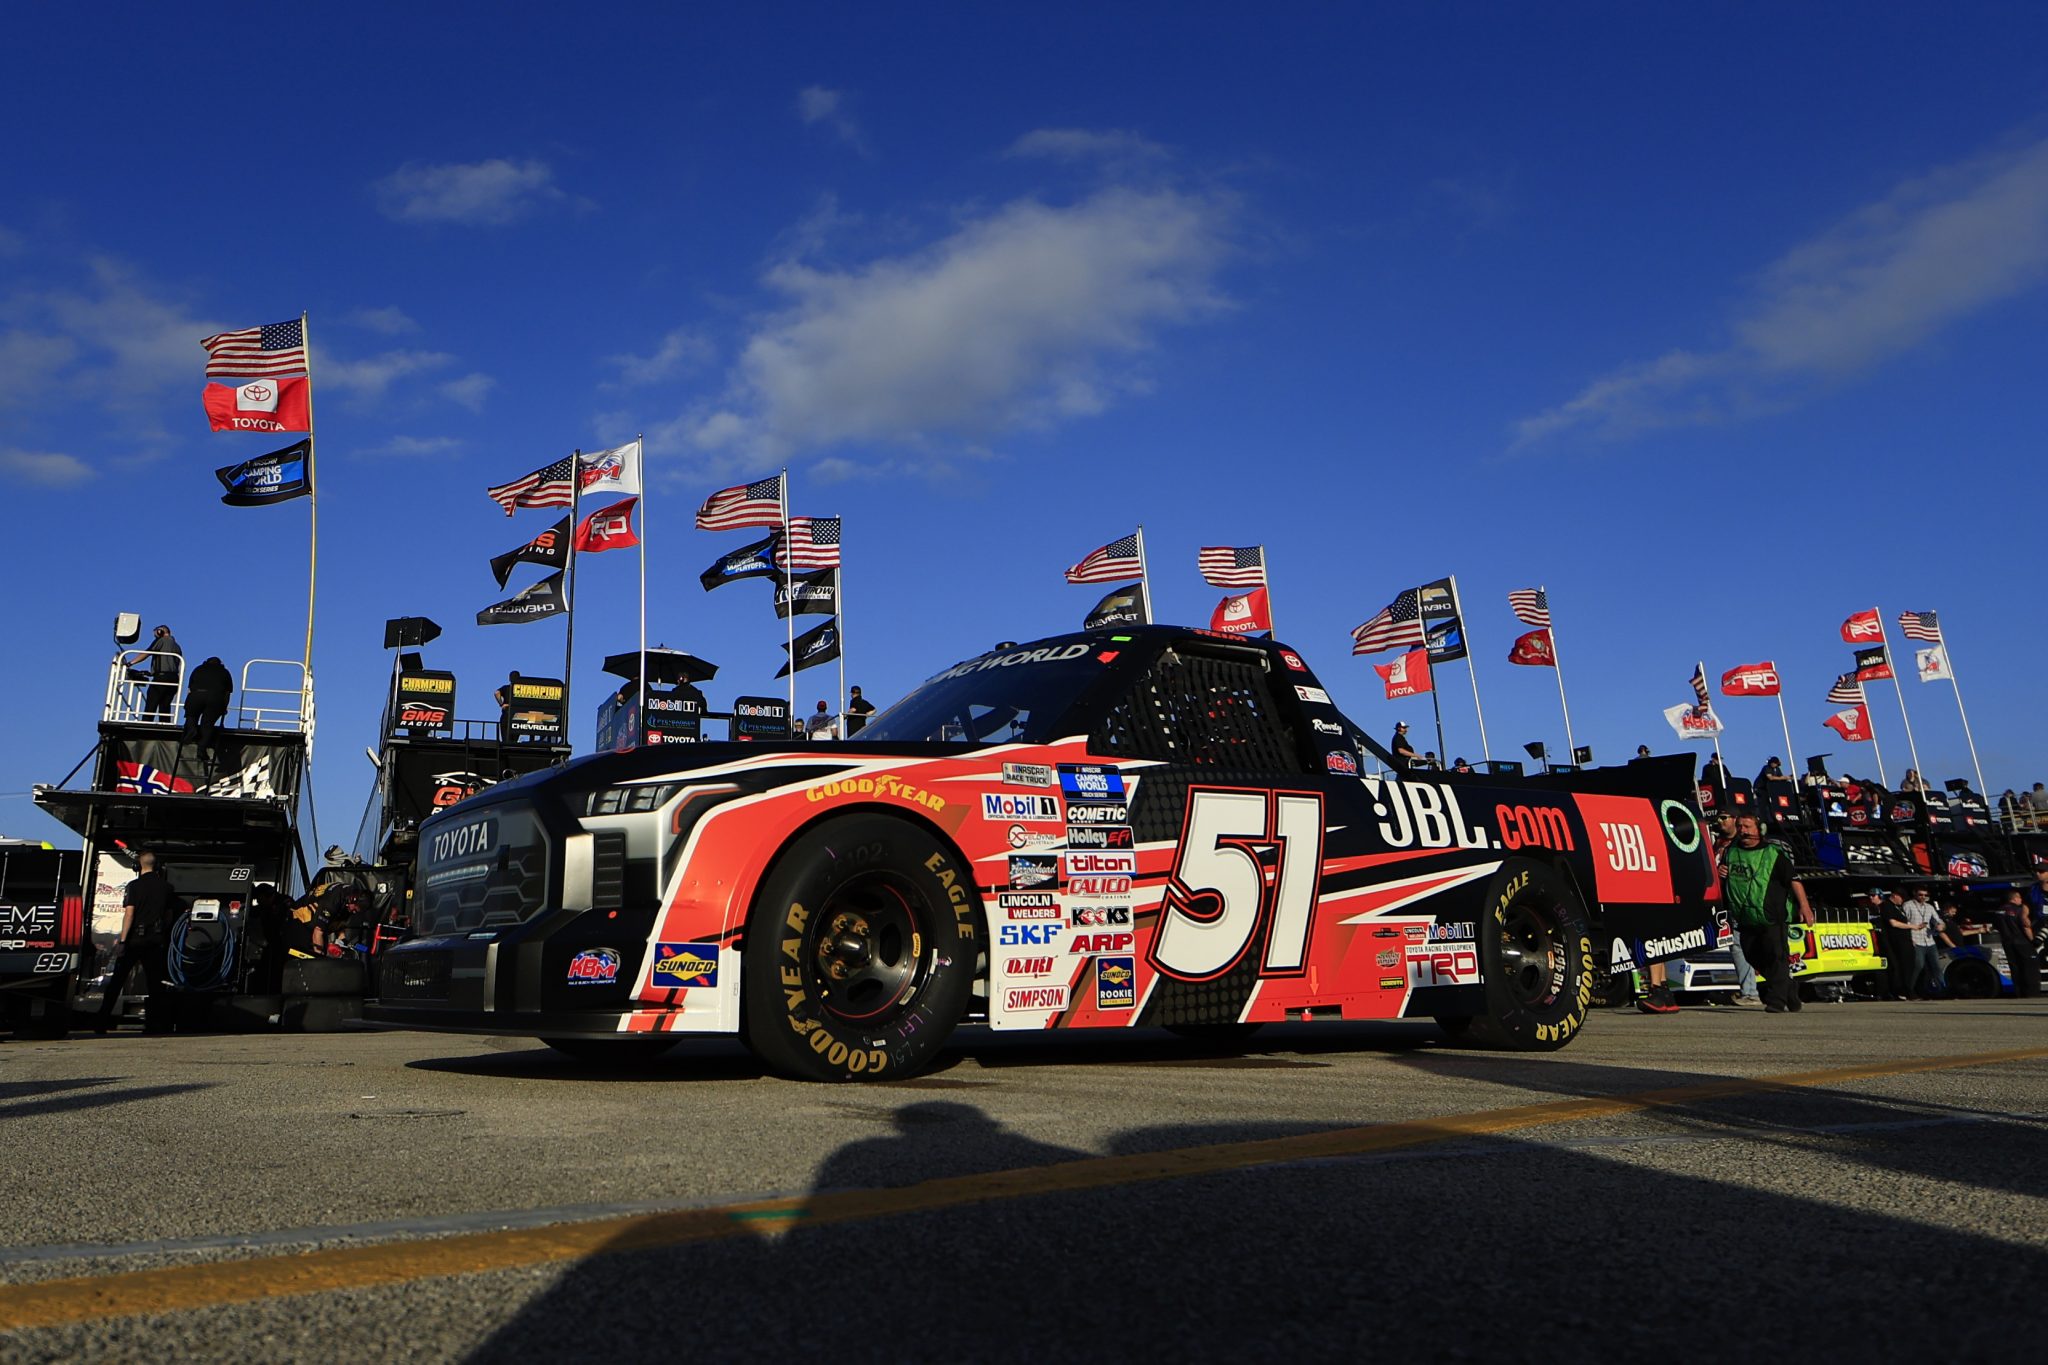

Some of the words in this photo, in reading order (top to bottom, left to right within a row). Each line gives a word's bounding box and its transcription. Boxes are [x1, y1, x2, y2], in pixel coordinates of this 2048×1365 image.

[232, 417, 285, 431] TOYOTA
[1085, 613, 1139, 630] CHEVROLET
[1221, 621, 1258, 633] TOYOTA
[976, 643, 1091, 672] WORLD
[402, 678, 453, 692] CHAMPION
[513, 684, 563, 698] CHAMPION
[1389, 685, 1415, 697] YOTA
[648, 698, 682, 711] Mobil
[739, 704, 771, 717] Mobil
[400, 720, 444, 728] RACING
[402, 710, 446, 722] GMS
[511, 723, 560, 732] CHEVROLET
[662, 735, 696, 744] TOYOTA
[1018, 765, 1045, 776] NASCAR
[1326, 755, 1358, 774] KBM
[1006, 773, 1024, 782] RACE
[1025, 776, 1048, 785] TRUCK
[1075, 774, 1107, 783] CAMPING
[1077, 781, 1109, 791] WORLD
[806, 774, 946, 813] GOODYEAR
[986, 795, 1036, 815] Mobil
[1067, 804, 1127, 821] COMETIC
[433, 821, 489, 863] TOYOTA
[1068, 828, 1107, 849] Holley
[1602, 822, 1657, 872] JBL
[1070, 855, 1132, 872] tilton
[229, 868, 250, 880] 99
[1068, 877, 1132, 895] CALICO
[1152, 788, 1322, 977] 51
[924, 851, 974, 941] EAGLE
[1001, 894, 1050, 907] LINCOLN
[1494, 870, 1529, 925] EAGLE
[1013, 908, 1056, 919] WELDERS
[1000, 924, 1063, 946] SKF
[1429, 922, 1461, 940] Mobil
[1069, 932, 1134, 953] ARP
[1424, 945, 1442, 953] RACING
[1443, 943, 1475, 952] DEVELOPMENT
[1820, 934, 1869, 950] MENARDS
[33, 952, 70, 973] 99
[567, 955, 617, 979] KBM
[658, 960, 715, 973] SUNOCO
[1407, 951, 1477, 985] TRD
[1610, 961, 1636, 975] AXALTA
[1101, 970, 1132, 980] SUNOCO
[780, 901, 888, 1073] GOODYEAR
[1099, 989, 1133, 999] ROOKIE
[1535, 936, 1593, 1042] GOODYEAR
[1007, 988, 1065, 1009] SIMPSON
